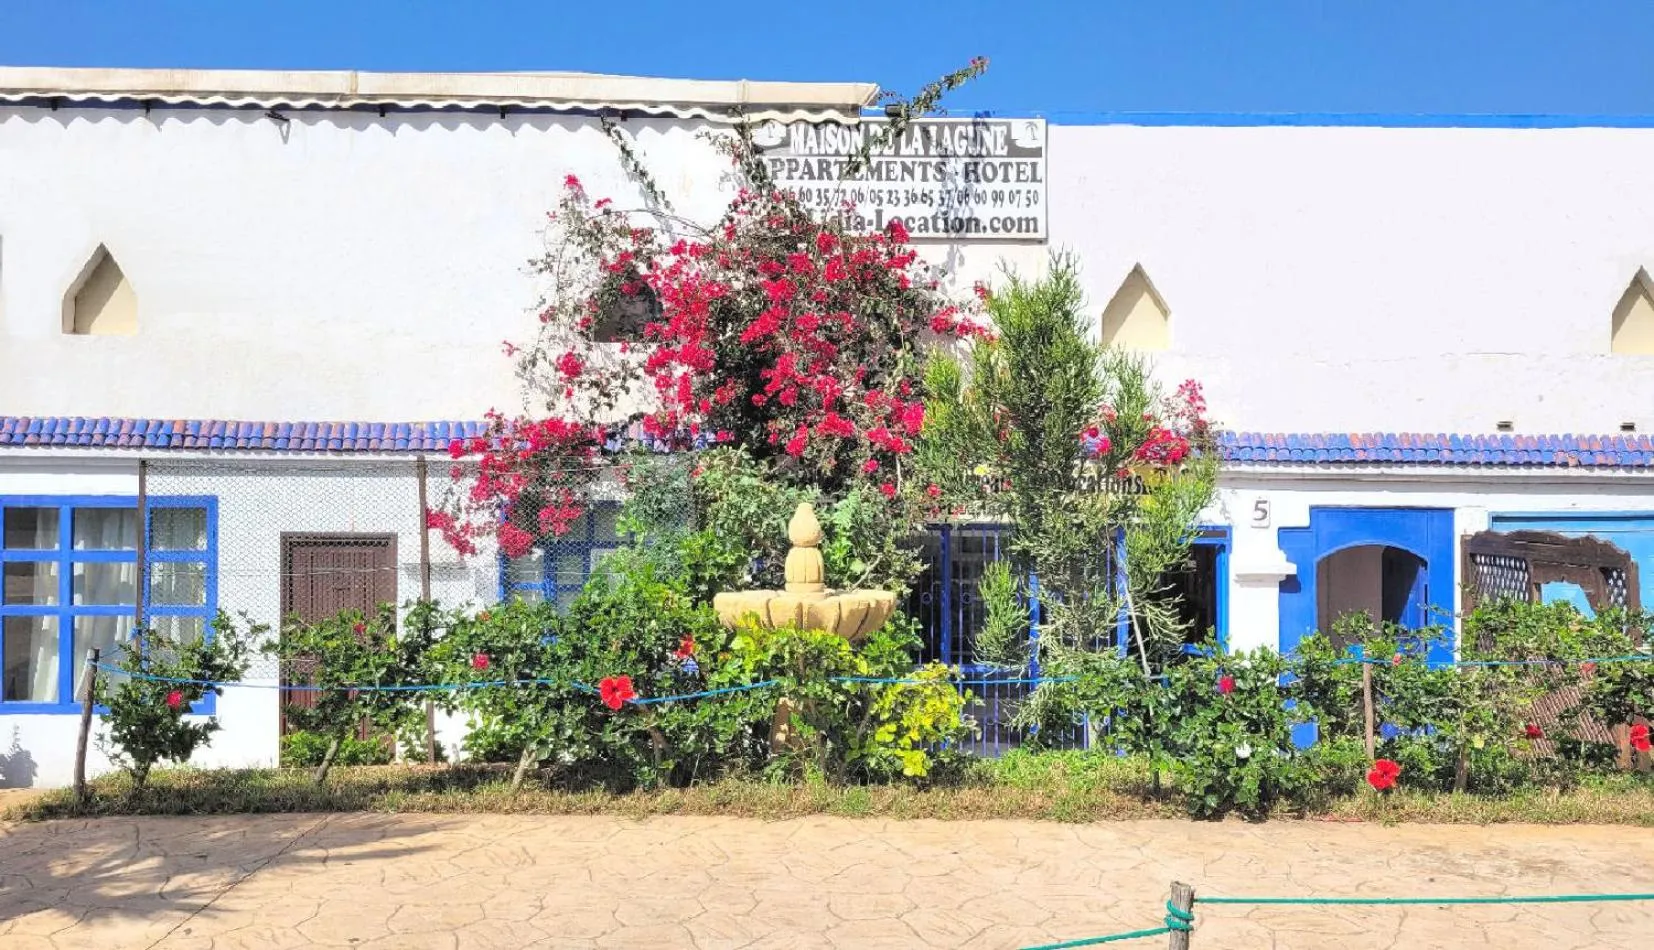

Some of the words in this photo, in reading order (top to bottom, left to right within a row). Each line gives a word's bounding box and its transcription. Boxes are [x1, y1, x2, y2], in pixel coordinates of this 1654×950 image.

[790, 122, 865, 156] MAISON
[899, 124, 925, 156] LA
[929, 124, 1008, 156] LAGUNE
[760, 158, 947, 183] PPARTMENTS
[964, 161, 1042, 184] HOTEL
[815, 188, 830, 207] 35
[1008, 190, 1022, 208] 07
[1025, 190, 1039, 208] 50
[1253, 499, 1268, 521] 5
